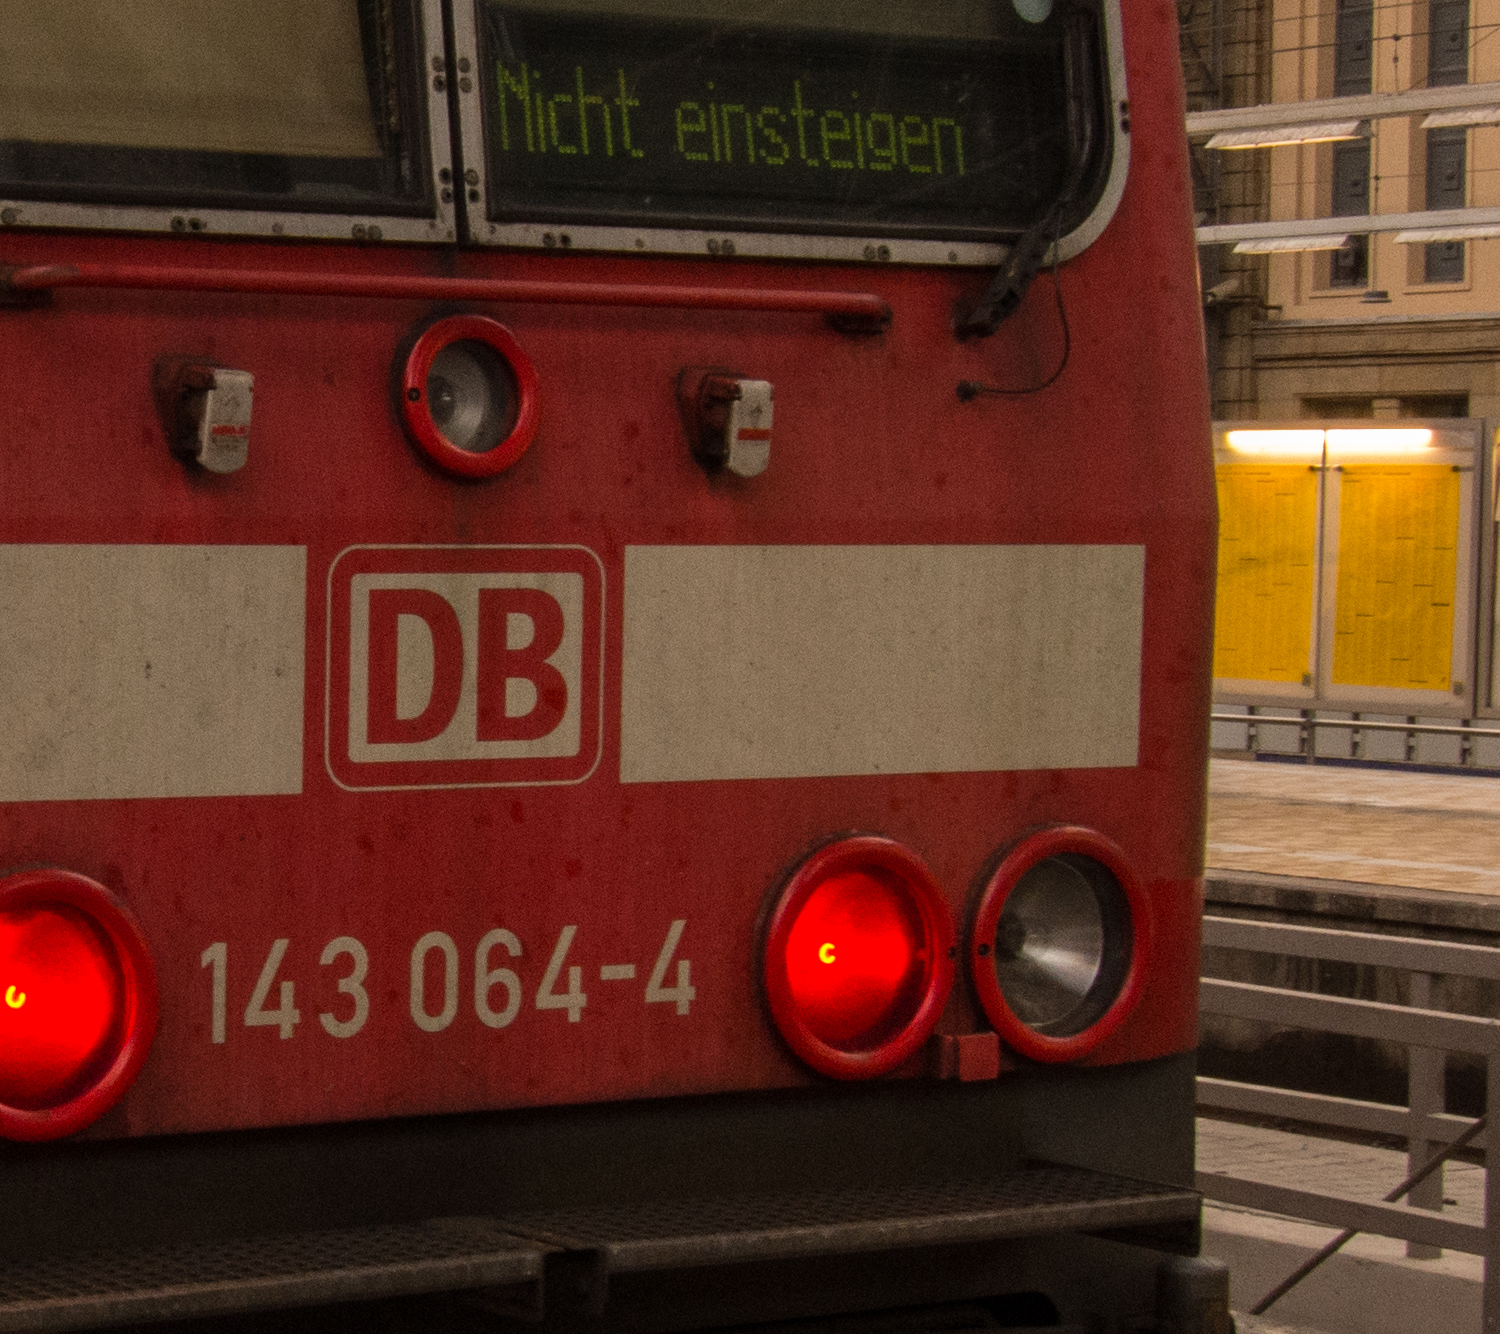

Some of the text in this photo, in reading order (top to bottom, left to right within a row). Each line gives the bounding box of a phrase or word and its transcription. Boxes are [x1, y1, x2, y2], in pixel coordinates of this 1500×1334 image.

[496, 60, 966, 175] Nicht einsteigen
[366, 586, 569, 745] DB
[199, 918, 697, 1045] 143 064-4
